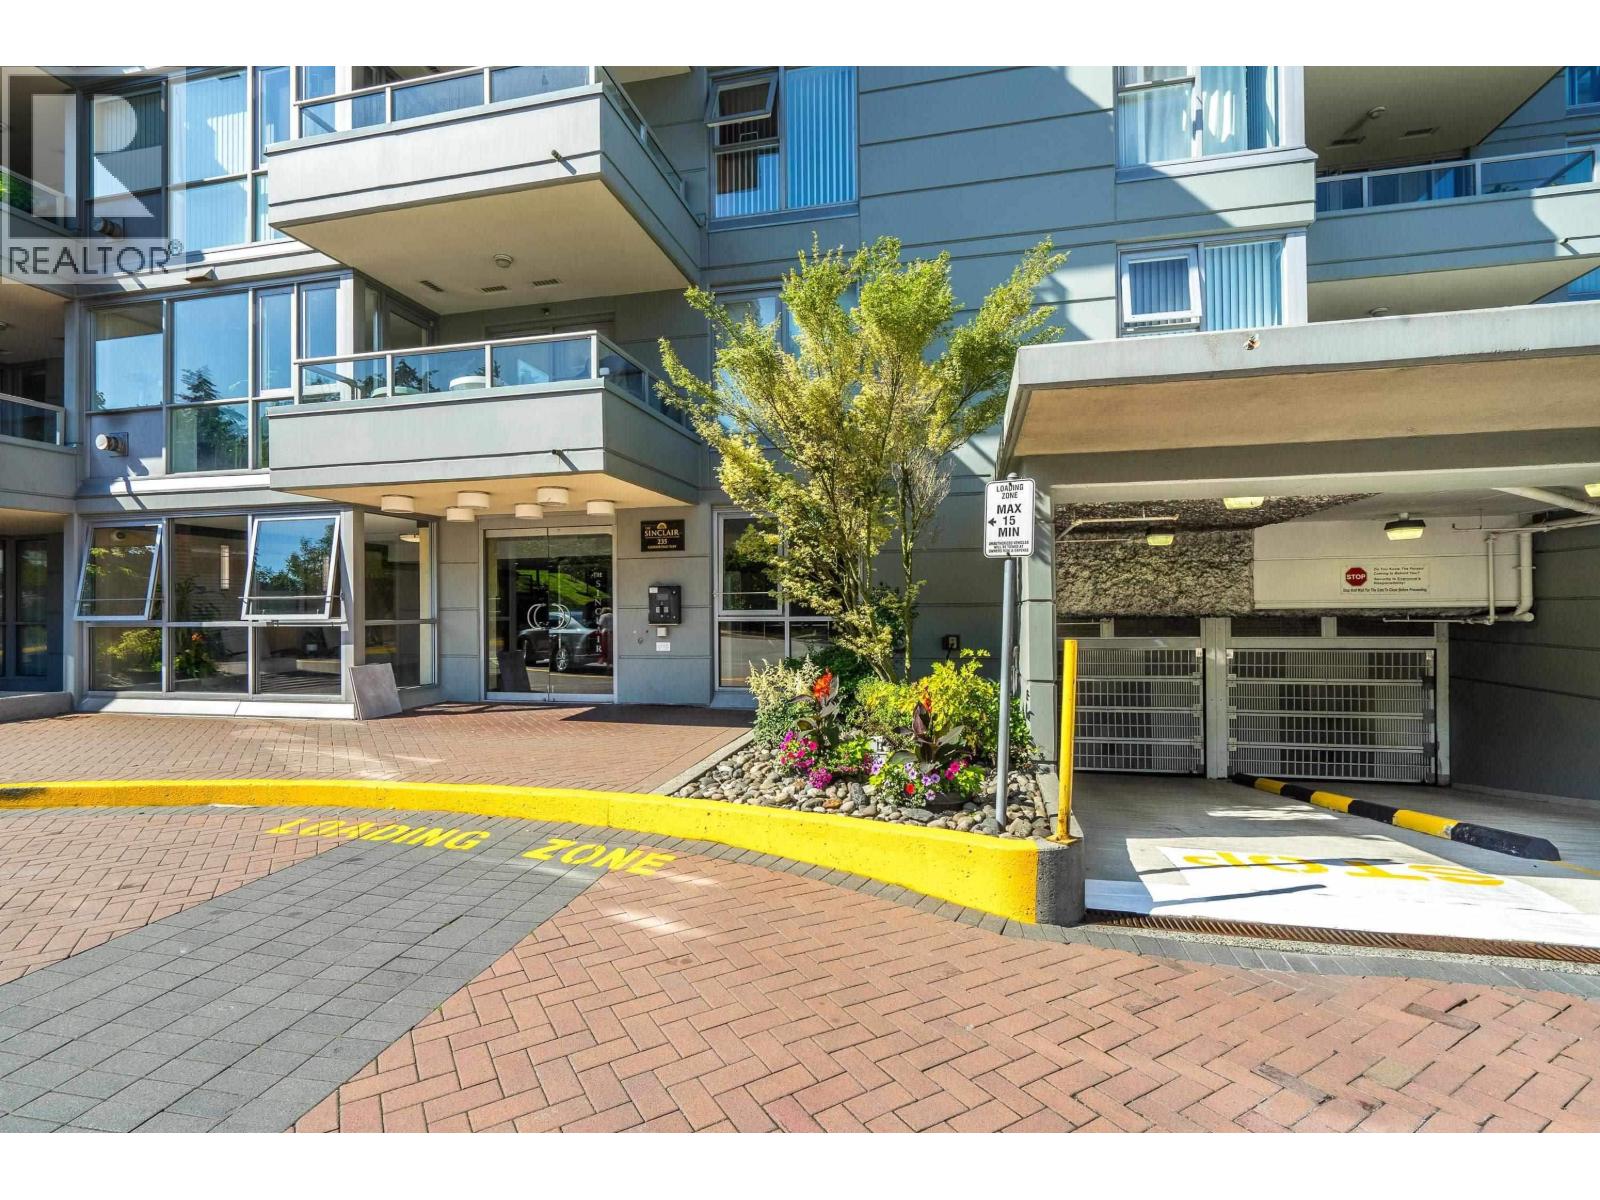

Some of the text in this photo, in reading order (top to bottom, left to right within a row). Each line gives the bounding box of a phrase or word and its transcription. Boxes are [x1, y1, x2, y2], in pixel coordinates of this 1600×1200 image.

[996, 484, 1024, 493] LOADING
[996, 503, 1022, 515] MAX
[1002, 515, 1016, 526] 15
[644, 529, 680, 537] SINCLAIR
[998, 527, 1020, 537] MIN
[264, 818, 678, 876] LOADING ZONE
